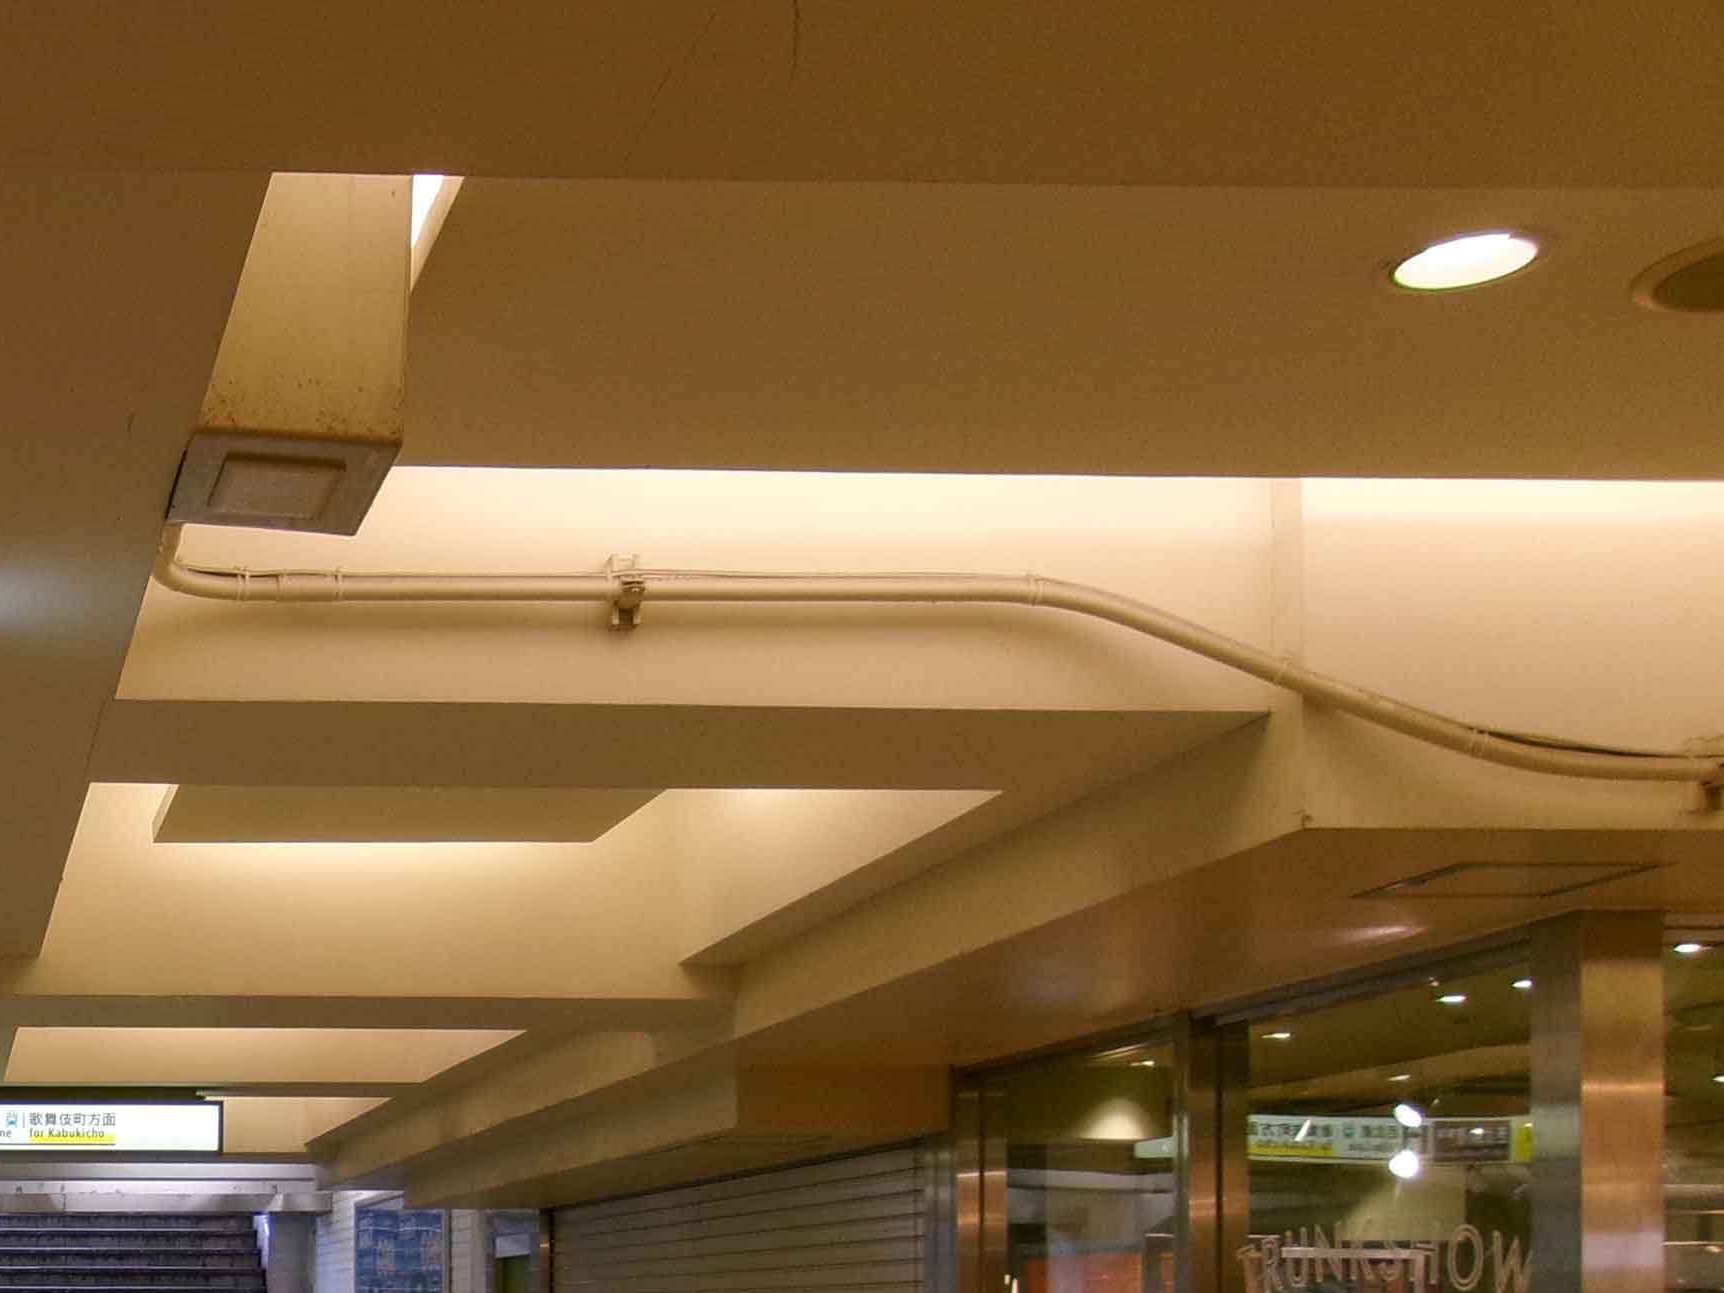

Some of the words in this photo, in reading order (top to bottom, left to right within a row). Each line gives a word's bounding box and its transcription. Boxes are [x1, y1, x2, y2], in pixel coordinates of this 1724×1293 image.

[29, 1112, 116, 1126] 歌舞伎町方面
[29, 1127, 44, 1138] for
[48, 1127, 105, 1138] Kabukicho
